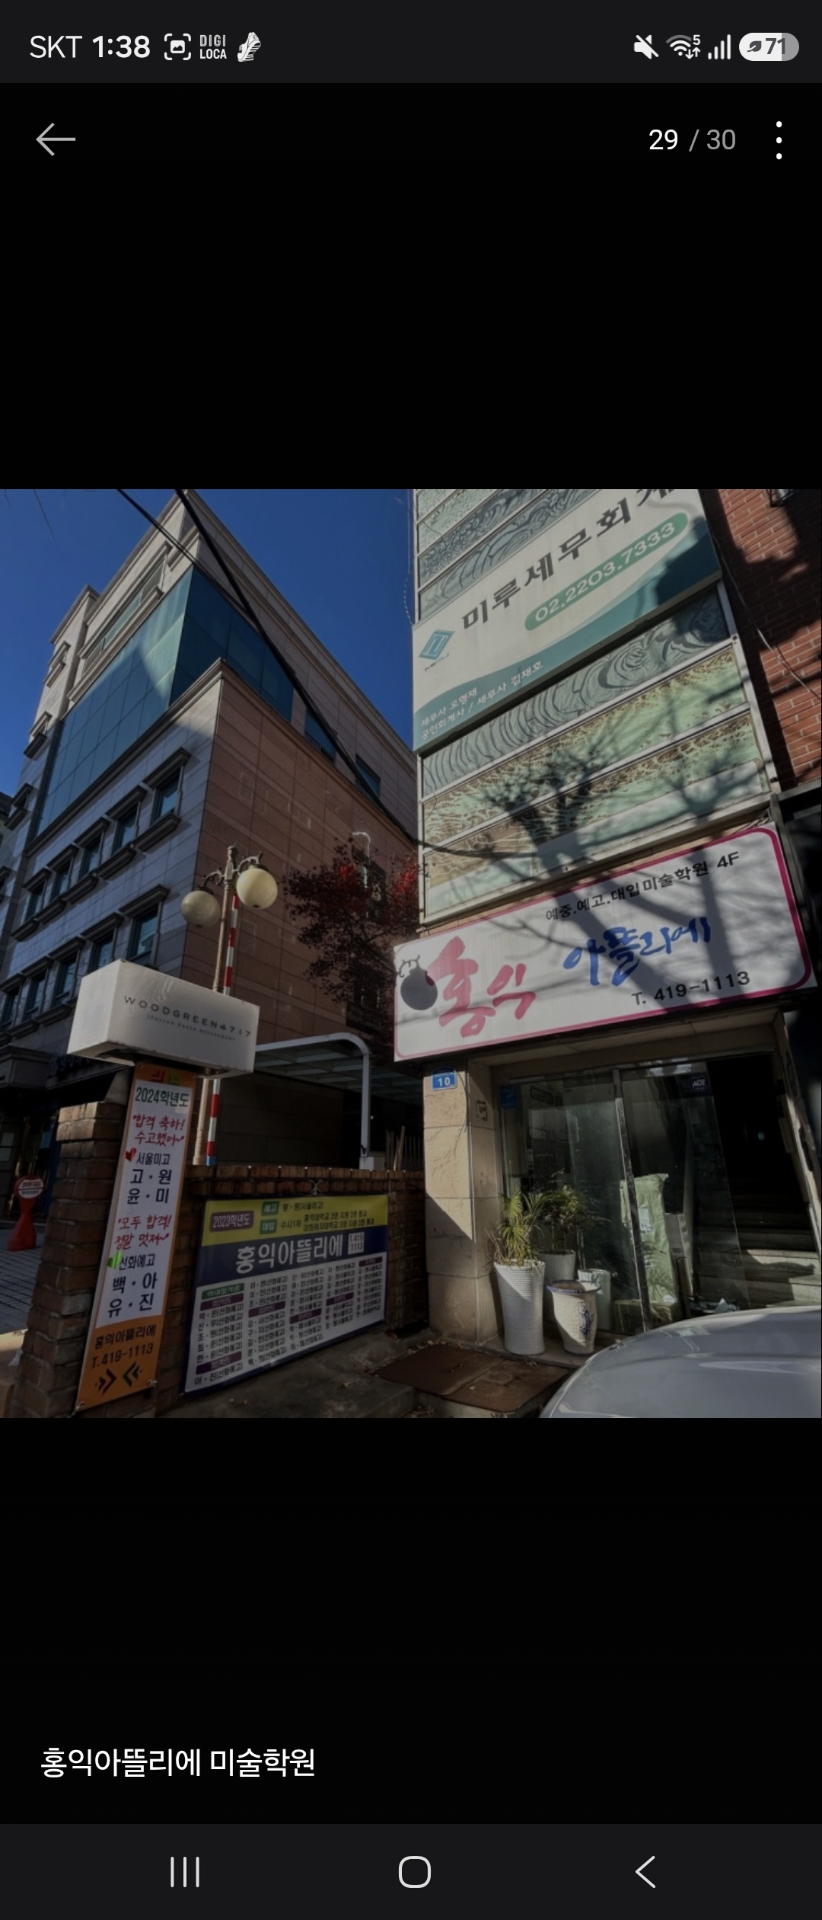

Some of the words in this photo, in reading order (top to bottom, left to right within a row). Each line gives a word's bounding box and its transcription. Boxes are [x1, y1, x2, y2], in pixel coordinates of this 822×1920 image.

[535, 521, 677, 622] 02.2203.7333
[421, 708, 465, 740] 공인회계사
[477, 682, 507, 705] 세무사
[421, 705, 447, 726] 세무사
[717, 851, 740, 869] 4F
[427, 936, 536, 1038] 홍익
[563, 917, 711, 986] 아뜰리에
[654, 971, 750, 1001] 419-1113
[124, 995, 251, 1037] WOODGREEN4717
[438, 1077, 451, 1087] 10
[692, 1078, 706, 1088] ADT
[135, 1087, 189, 1107] 2024학년도
[159, 1115, 186, 1131] 축하!
[136, 1153, 170, 1166] 서울미고
[146, 1214, 173, 1231] 합격!
[212, 1213, 251, 1229] 2023학년도
[114, 1233, 134, 1251] 정말
[119, 1253, 156, 1271] 선화예고
[235, 1233, 344, 1275] 홍익아뜰리에
[94, 1324, 157, 1350] 홍익아뜰리에
